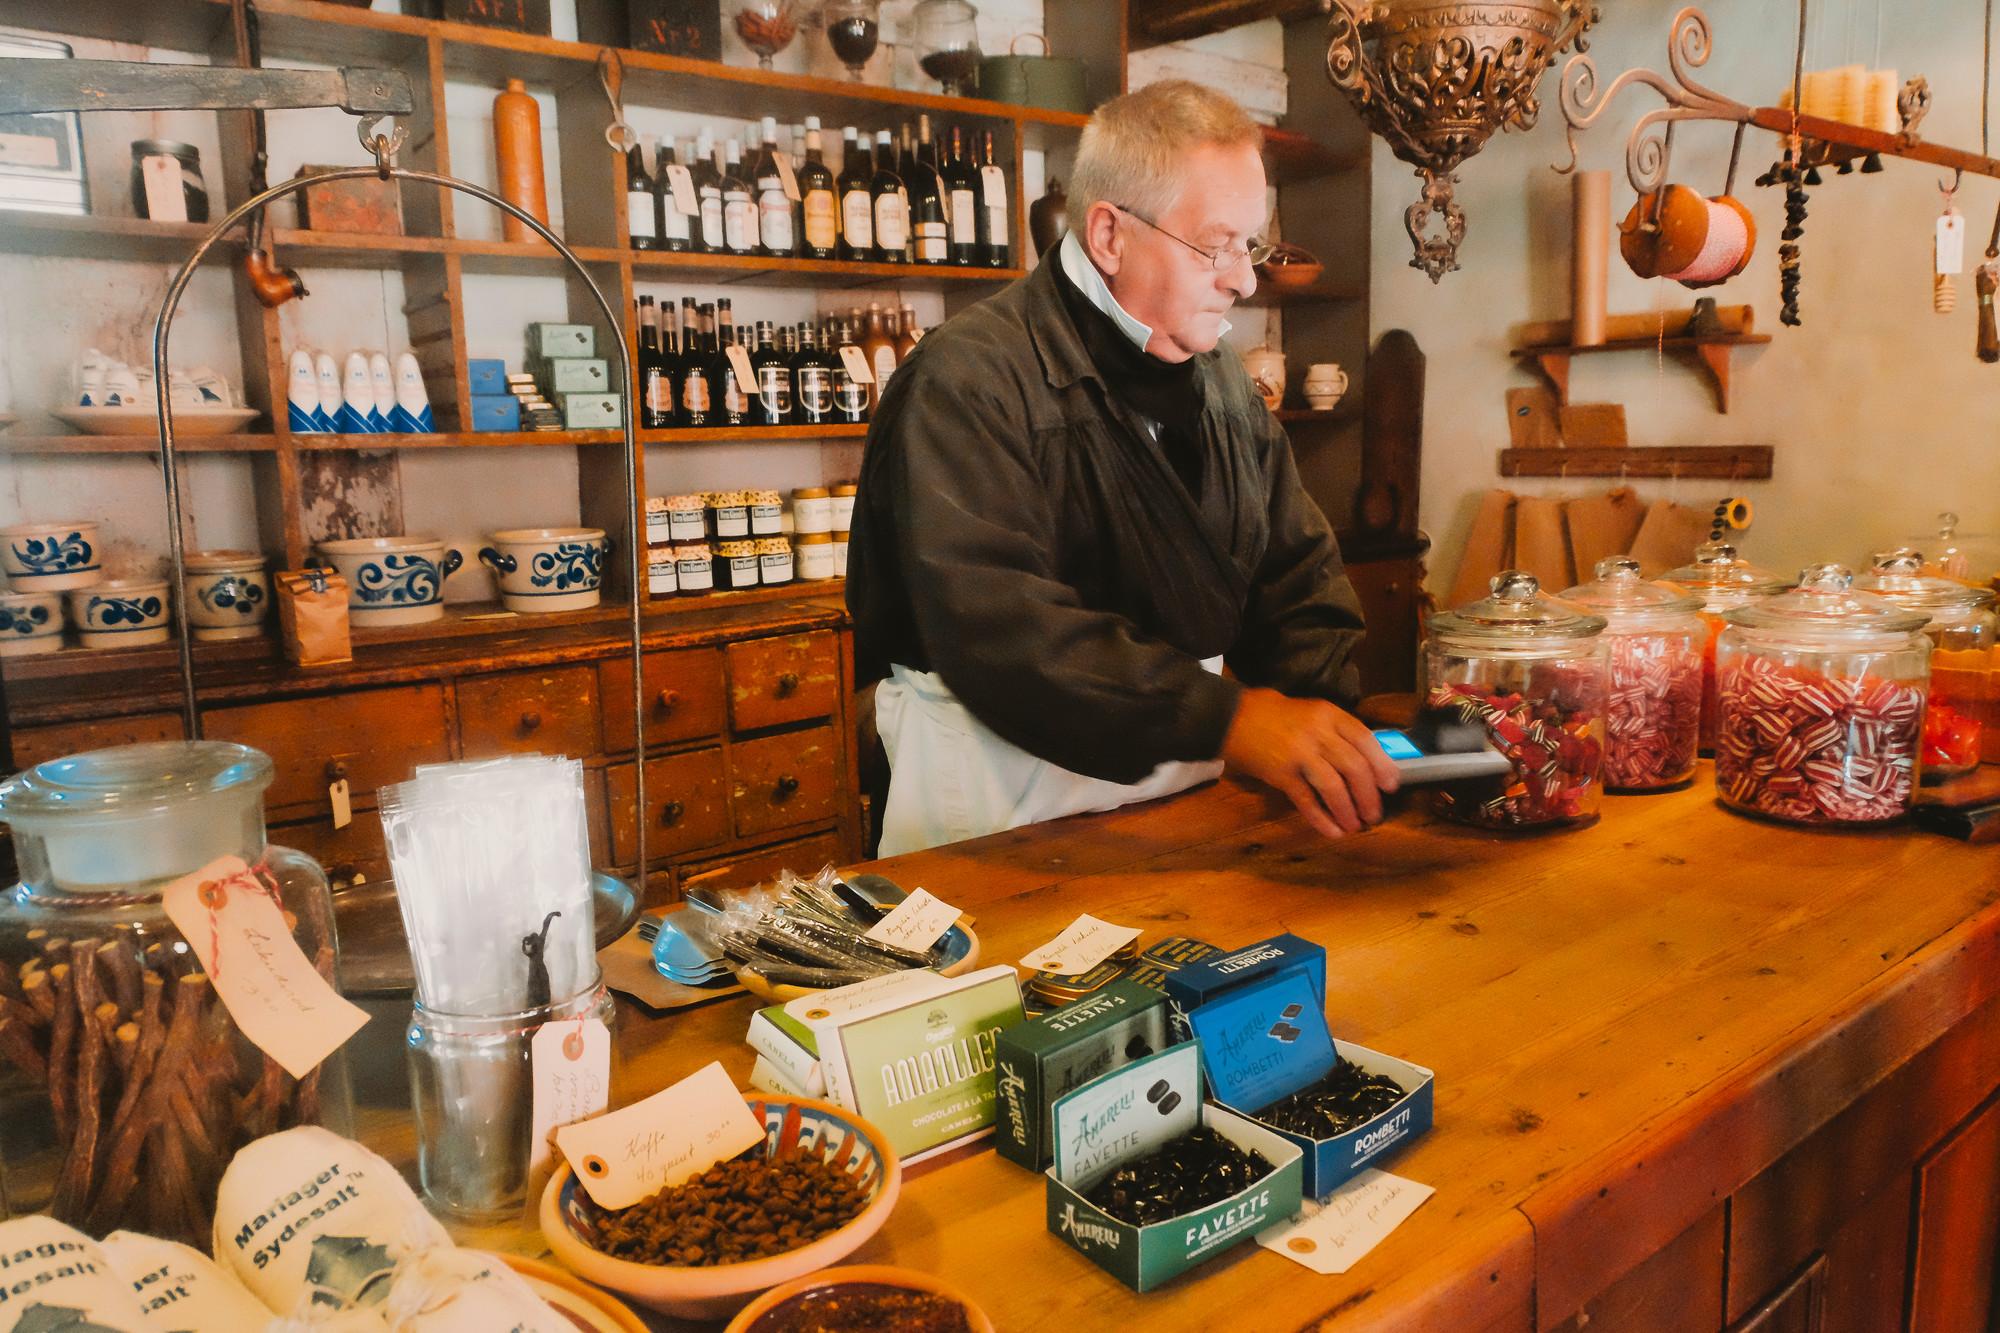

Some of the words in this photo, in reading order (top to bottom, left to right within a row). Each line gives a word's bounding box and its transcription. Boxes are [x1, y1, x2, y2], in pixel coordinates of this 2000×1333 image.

[1218, 947, 1285, 975] ROMBETTI
[1050, 996, 1127, 1033] FAVETTE
[1224, 1050, 1285, 1088] ROMBETTI
[912, 1103, 962, 1128] CHOCOLATE
[941, 1113, 983, 1134] CANELA
[1354, 1107, 1411, 1155] ROMBETTI
[1074, 1130, 1140, 1177] FAVETTE
[234, 1163, 341, 1250] Mariager
[1185, 1189, 1271, 1247] FAVETTE
